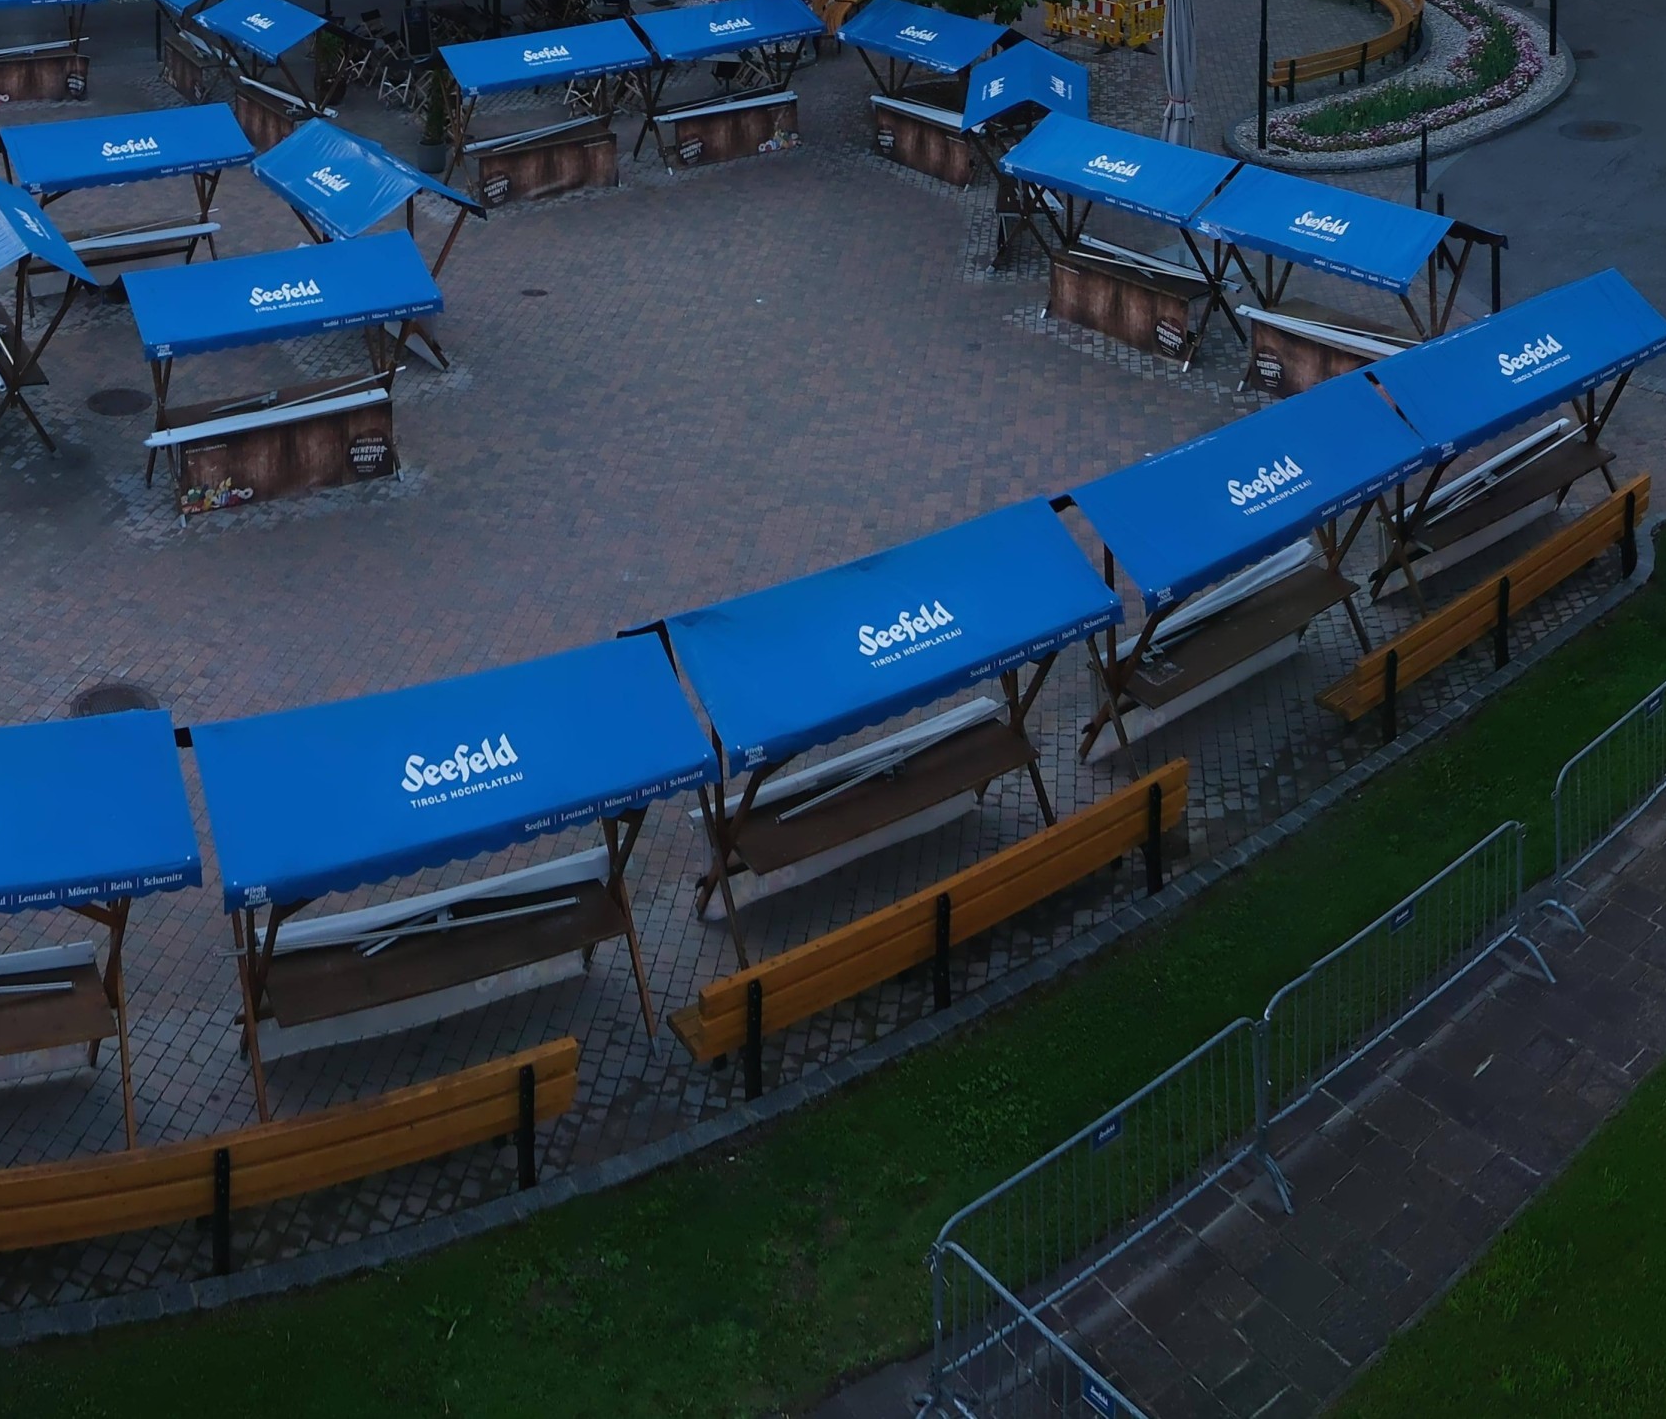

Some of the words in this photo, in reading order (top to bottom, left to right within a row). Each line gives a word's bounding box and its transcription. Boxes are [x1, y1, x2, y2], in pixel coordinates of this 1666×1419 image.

[709, 17, 752, 34] Seefeld
[900, 25, 939, 42] Seefeld
[523, 45, 569, 63] Seefeld
[101, 137, 158, 157] Seefeld
[311, 165, 351, 193] Seefeld
[1088, 153, 1141, 178] Seefeld
[1294, 210, 1351, 237] Seefeld
[249, 278, 321, 306] Seefeld
[254, 304, 277, 314] TIROLS
[278, 297, 324, 310] HOCHPLATEAU
[1498, 334, 1563, 376] Seefeld
[1227, 453, 1303, 507] Seefeld
[1242, 501, 1267, 516] TIROLS
[1267, 479, 1312, 506] HOCHPLATEAU
[859, 600, 955, 657] Seefeld
[870, 652, 902, 669] TIROLS
[903, 627, 963, 657] HOCHPLATEAU
[969, 662, 991, 679] Seefeld
[997, 650, 1025, 668] Leutasch
[1032, 638, 1055, 653] Mösern
[1061, 627, 1077, 642] Reith
[1083, 613, 1111, 631] Scharnitz
[400, 732, 519, 793] Seefeld
[410, 791, 448, 810] TIROLS
[449, 770, 525, 800] HOCHPLATEAU
[523, 817, 551, 833] Seefeld
[559, 804, 595, 823] Leutasch
[603, 793, 632, 809] Mösern
[641, 783, 661, 798] Reith
[668, 769, 704, 788] Scharnitz
[17, 889, 57, 904] Leutasch
[67, 883, 100, 898] Mösern
[109, 879, 134, 892] Reith
[143, 872, 184, 888] Scharnitz
